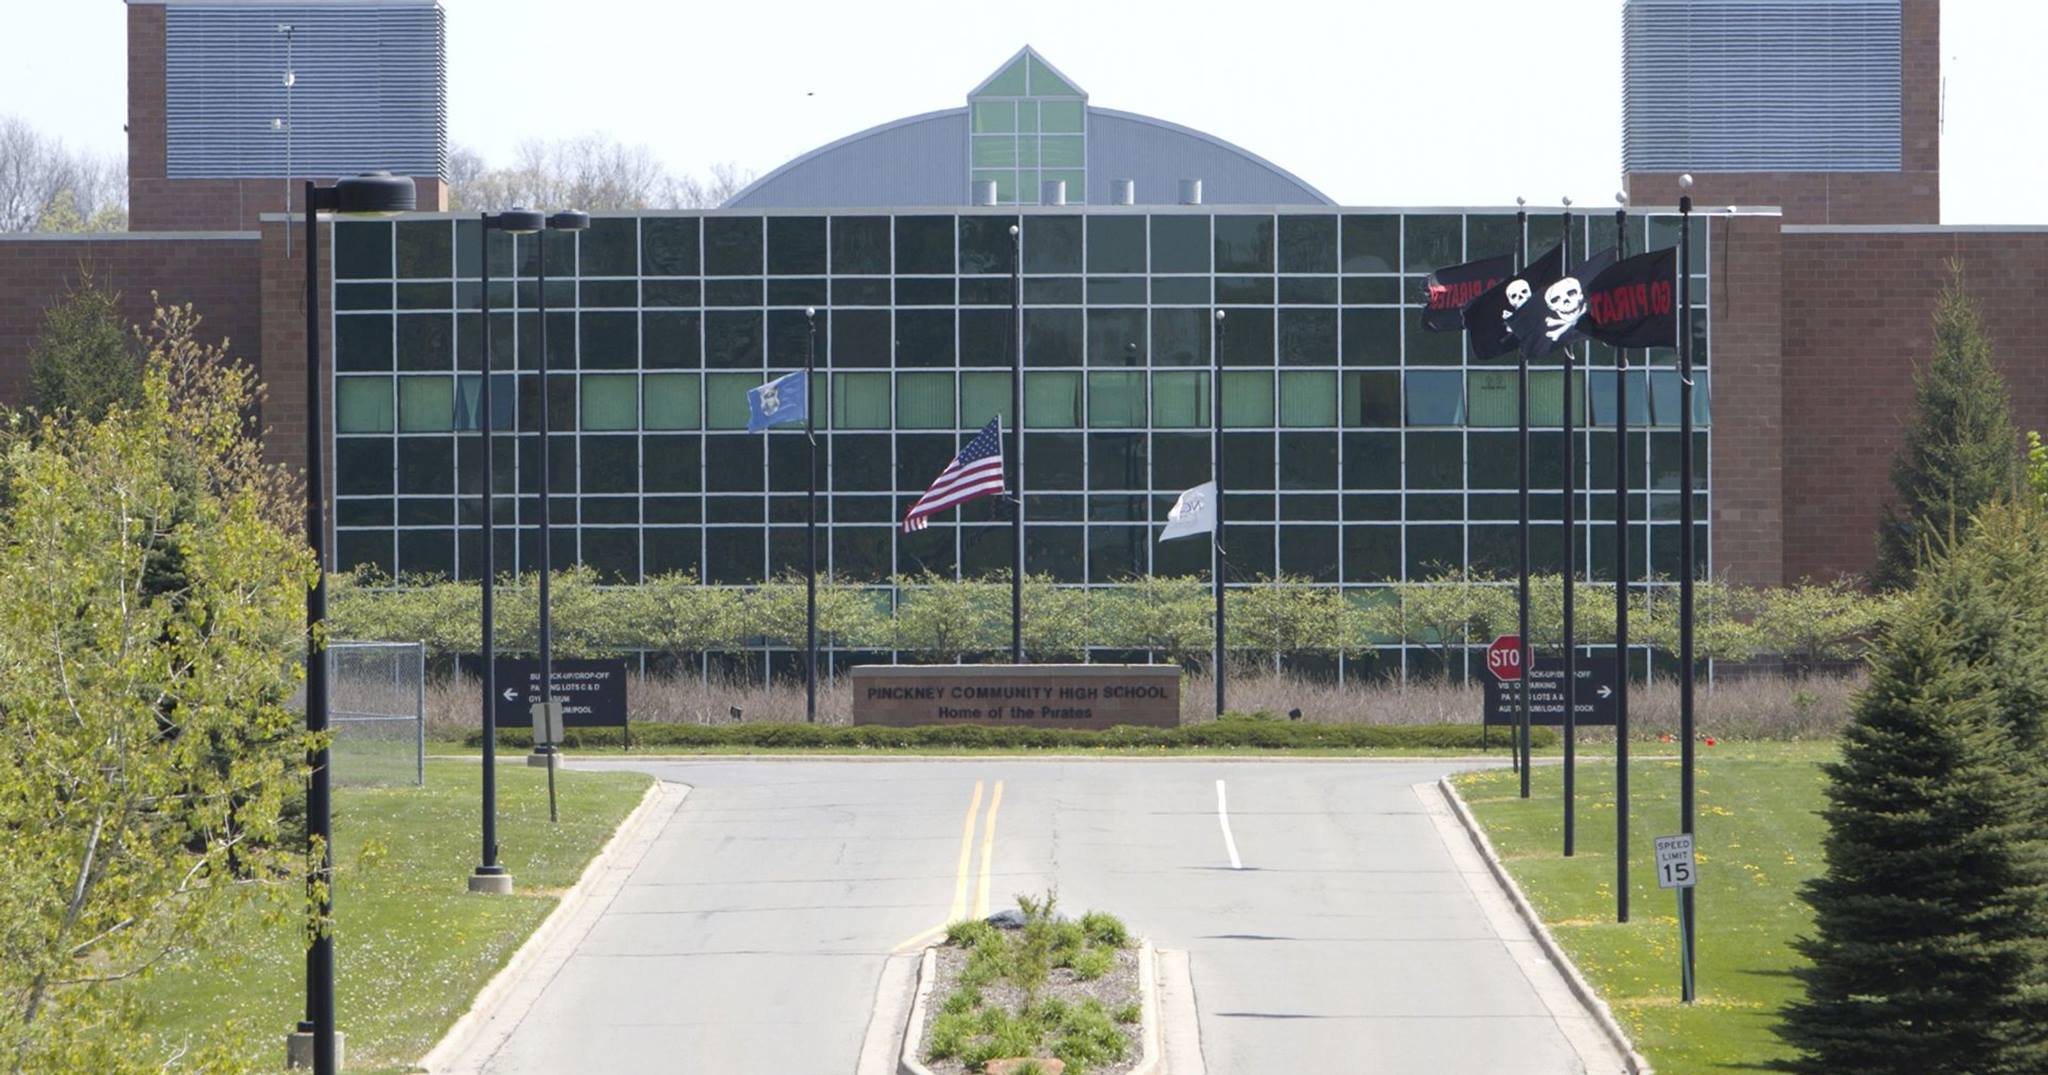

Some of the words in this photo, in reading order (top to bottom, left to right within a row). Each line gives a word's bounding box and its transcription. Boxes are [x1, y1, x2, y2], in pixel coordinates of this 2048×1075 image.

[1491, 649, 1520, 667] STO
[530, 683, 561, 692] PANG
[562, 683, 580, 692] LOTS
[1498, 681, 1521, 689] VISO
[868, 687, 945, 699] PINCKNEY
[951, 686, 1053, 699] COMMUNITY
[1060, 687, 1098, 699] HIGH
[1103, 686, 1168, 699] SCHOOL
[1533, 693, 1550, 701] LOTS
[939, 706, 982, 719] Home
[988, 707, 1003, 719] of
[1010, 706, 1034, 719] the
[1041, 706, 1093, 719] Pirates
[1574, 704, 1594, 712] DOCK
[1657, 840, 1690, 850] SPEED
[1662, 851, 1688, 861] LIMIT
[1664, 862, 1690, 882] 15
